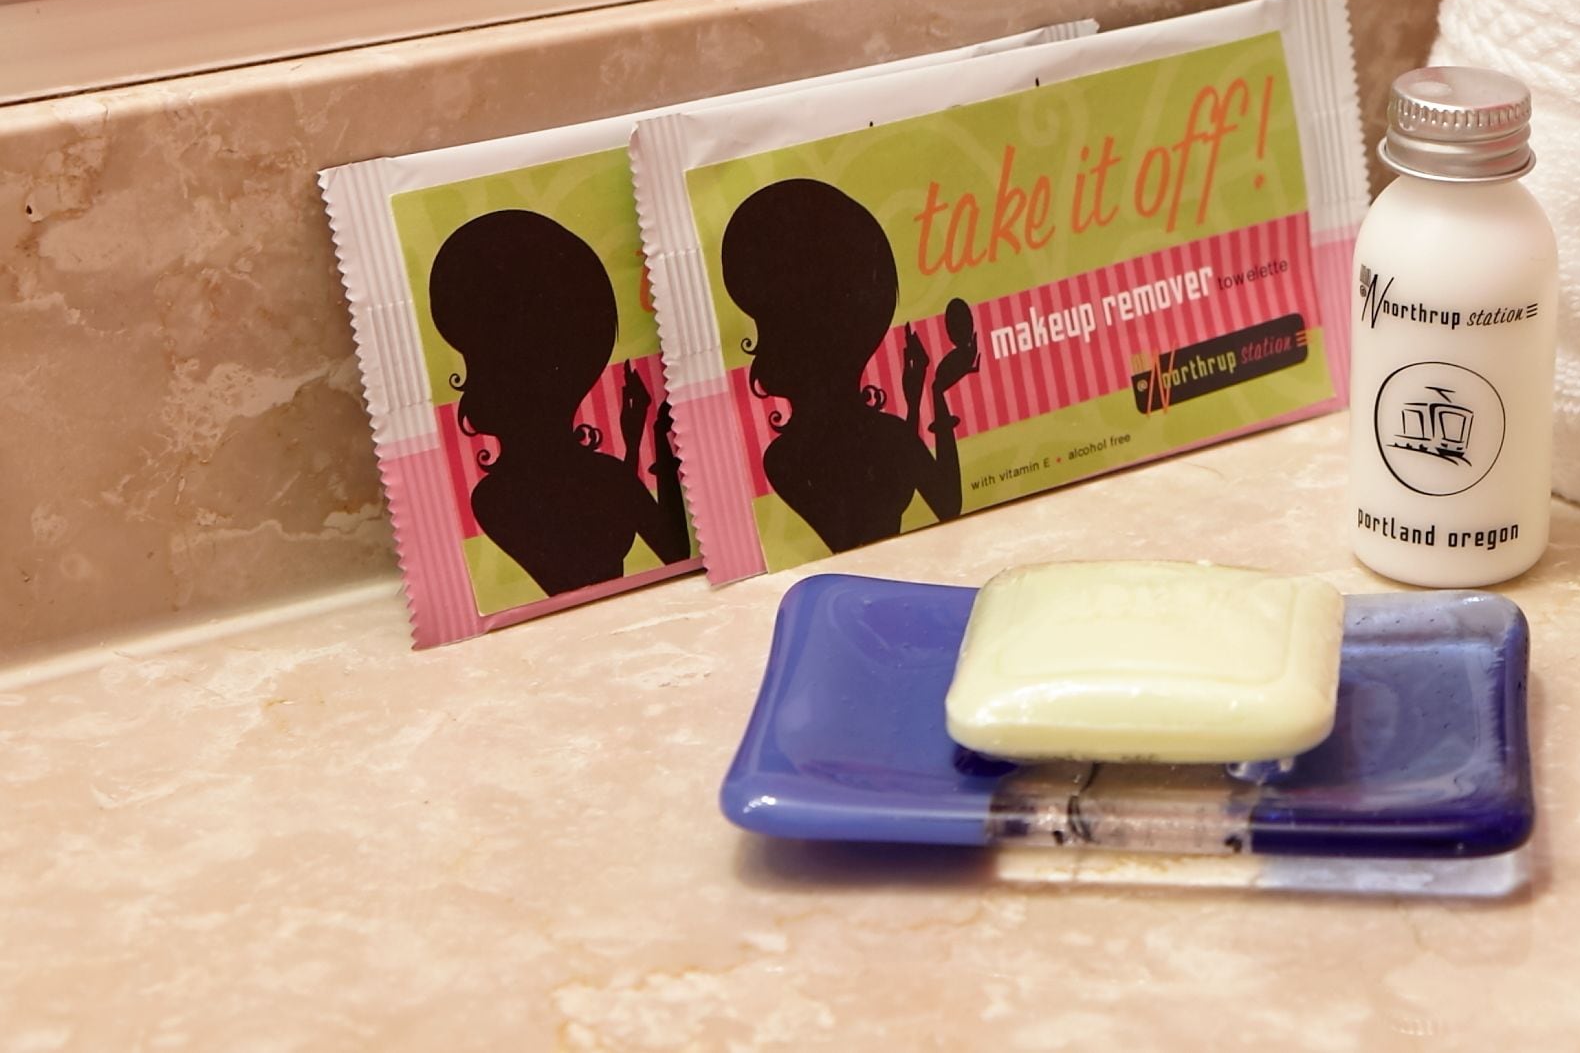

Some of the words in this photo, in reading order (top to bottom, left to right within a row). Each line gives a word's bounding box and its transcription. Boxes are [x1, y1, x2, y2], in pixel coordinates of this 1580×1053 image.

[914, 146, 1056, 276] take
[1071, 136, 1122, 234] it
[1133, 75, 1275, 233] off!
[990, 301, 1097, 359] makeup
[1102, 265, 1214, 326] remover
[1217, 257, 1289, 291] towelette
[1467, 306, 1524, 327] station
[1241, 334, 1292, 364] station
[971, 473, 996, 490] with
[999, 460, 1041, 484] vitamin
[1043, 457, 1051, 469] E
[1068, 439, 1108, 462] alcohol
[1109, 432, 1132, 450] free
[1358, 508, 1435, 546] portland
[1448, 524, 1519, 550] oregon
